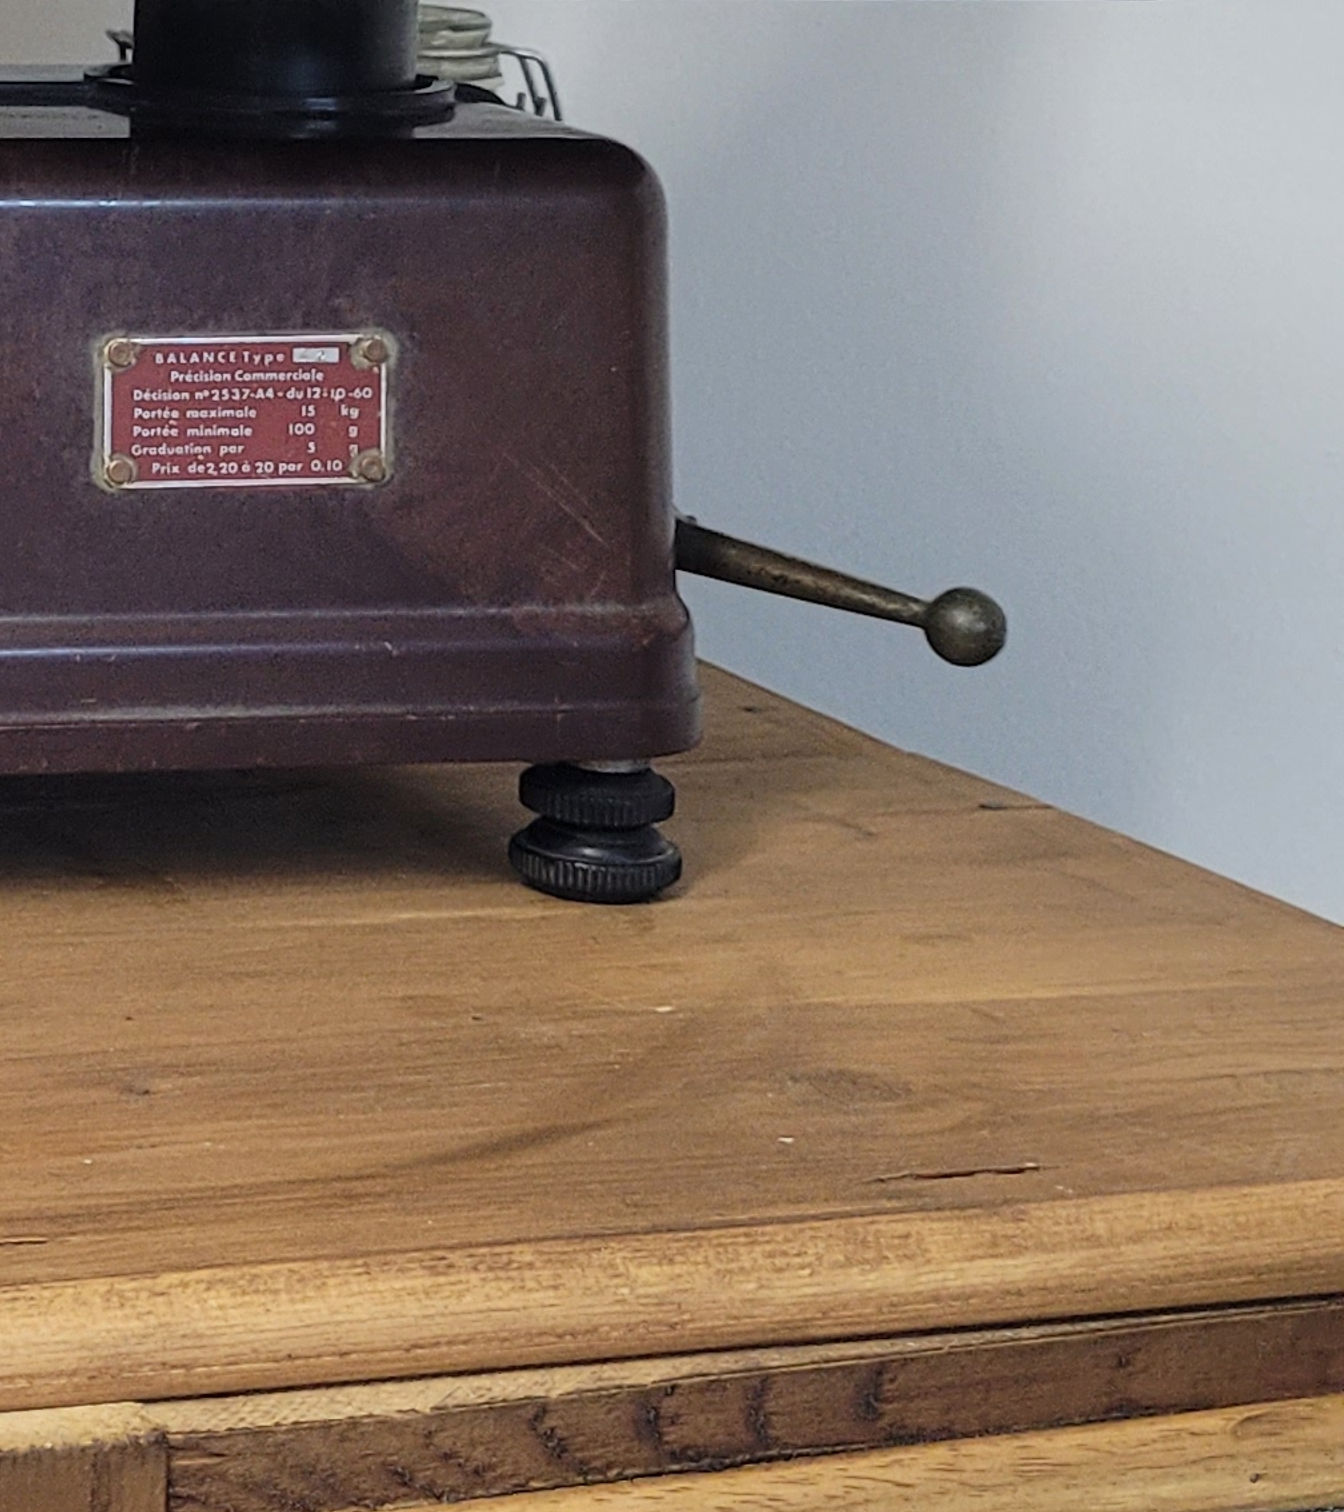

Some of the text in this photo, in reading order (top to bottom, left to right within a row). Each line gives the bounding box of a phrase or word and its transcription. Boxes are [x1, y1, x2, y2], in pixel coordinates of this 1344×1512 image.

[155, 351, 236, 364] BALANCE
[242, 351, 285, 367] Type
[170, 368, 324, 382] Précision Commerciale
[133, 389, 190, 401] Décision
[133, 404, 360, 419] Portée maximale 15 kg
[133, 423, 359, 438] Portée minimale 100 g
[131, 443, 212, 456] Graduation
[219, 445, 245, 457] par
[306, 441, 316, 453] 5
[152, 462, 180, 474] Prix
[241, 460, 251, 473] à
[254, 461, 274, 474] 20
[278, 462, 303, 475] par
